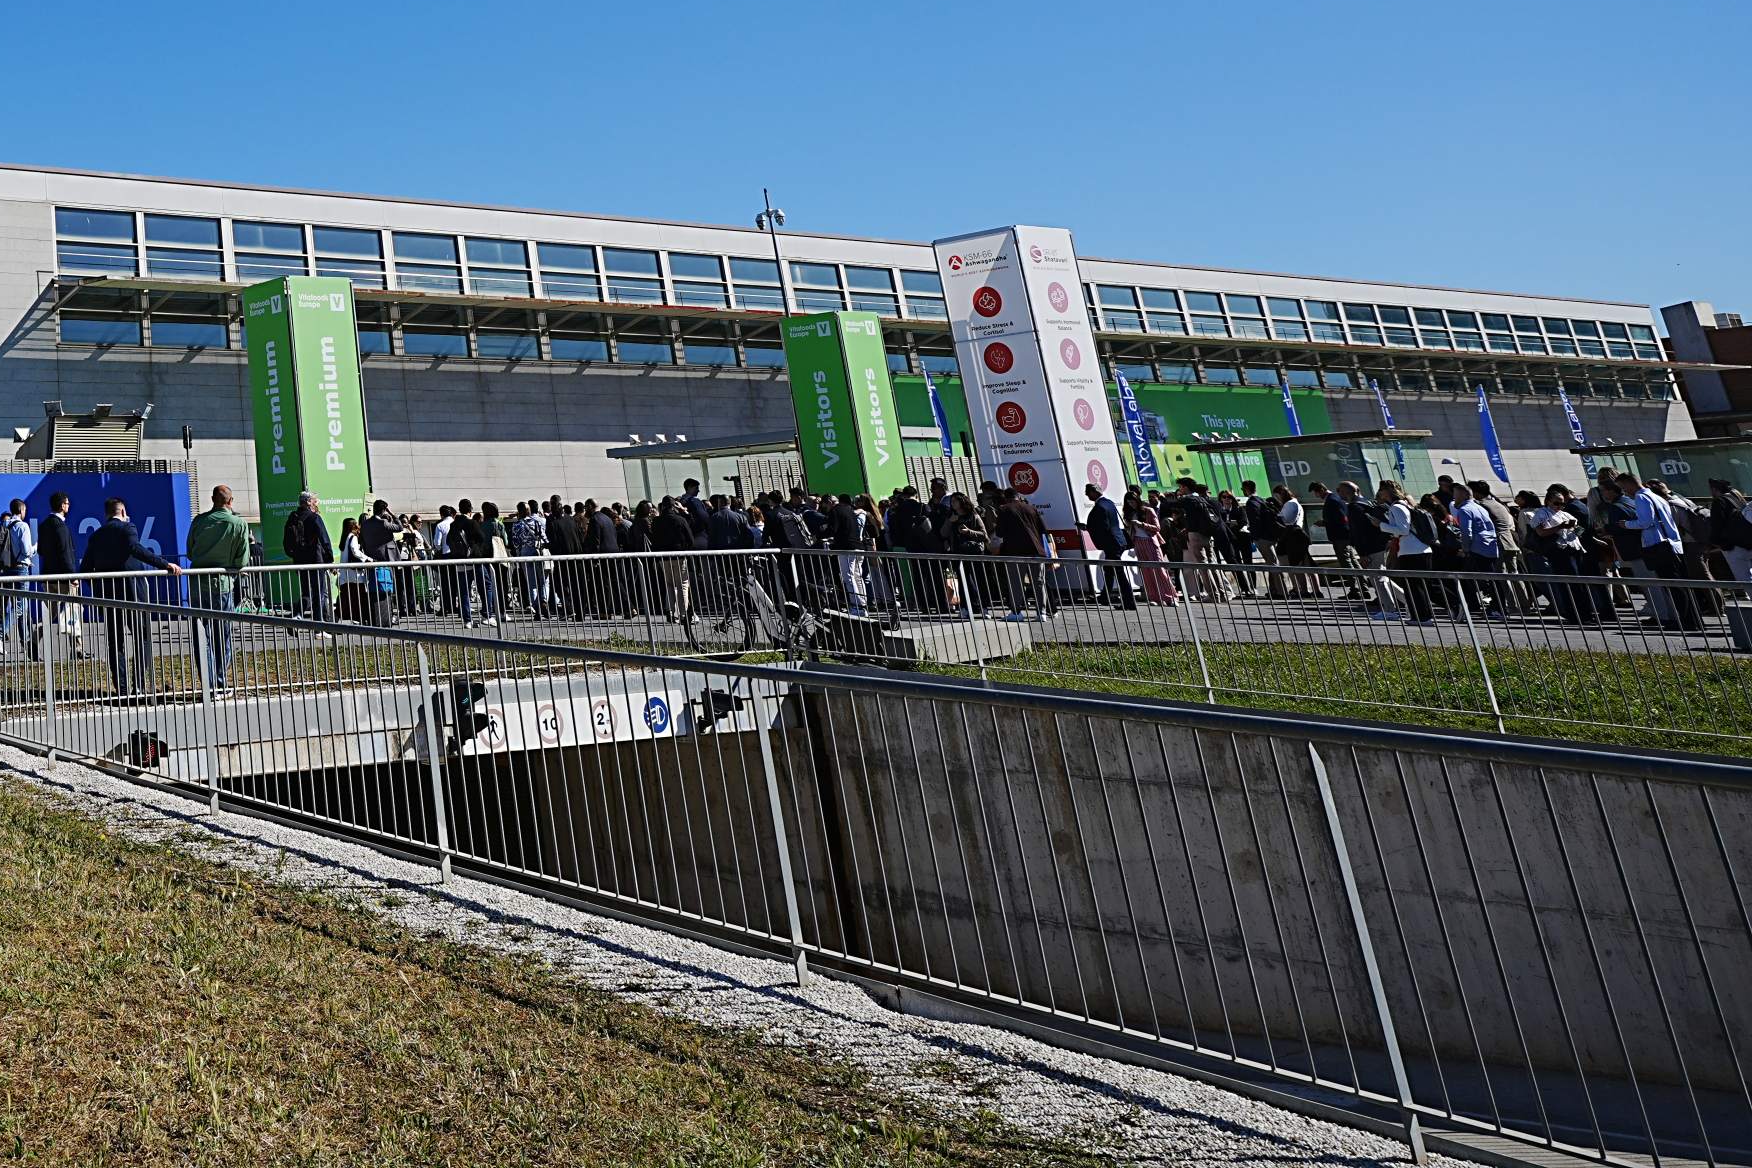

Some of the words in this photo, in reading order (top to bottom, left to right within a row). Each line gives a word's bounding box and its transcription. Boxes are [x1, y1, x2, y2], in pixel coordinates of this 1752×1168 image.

[265, 340, 286, 475] Premium
[319, 336, 346, 472] Premium
[813, 370, 841, 470] Visitors
[865, 368, 890, 467] Visitors
[1201, 414, 1223, 428] This
[1224, 418, 1249, 431] year,
[1210, 452, 1223, 466] to
[542, 717, 558, 731] 10
